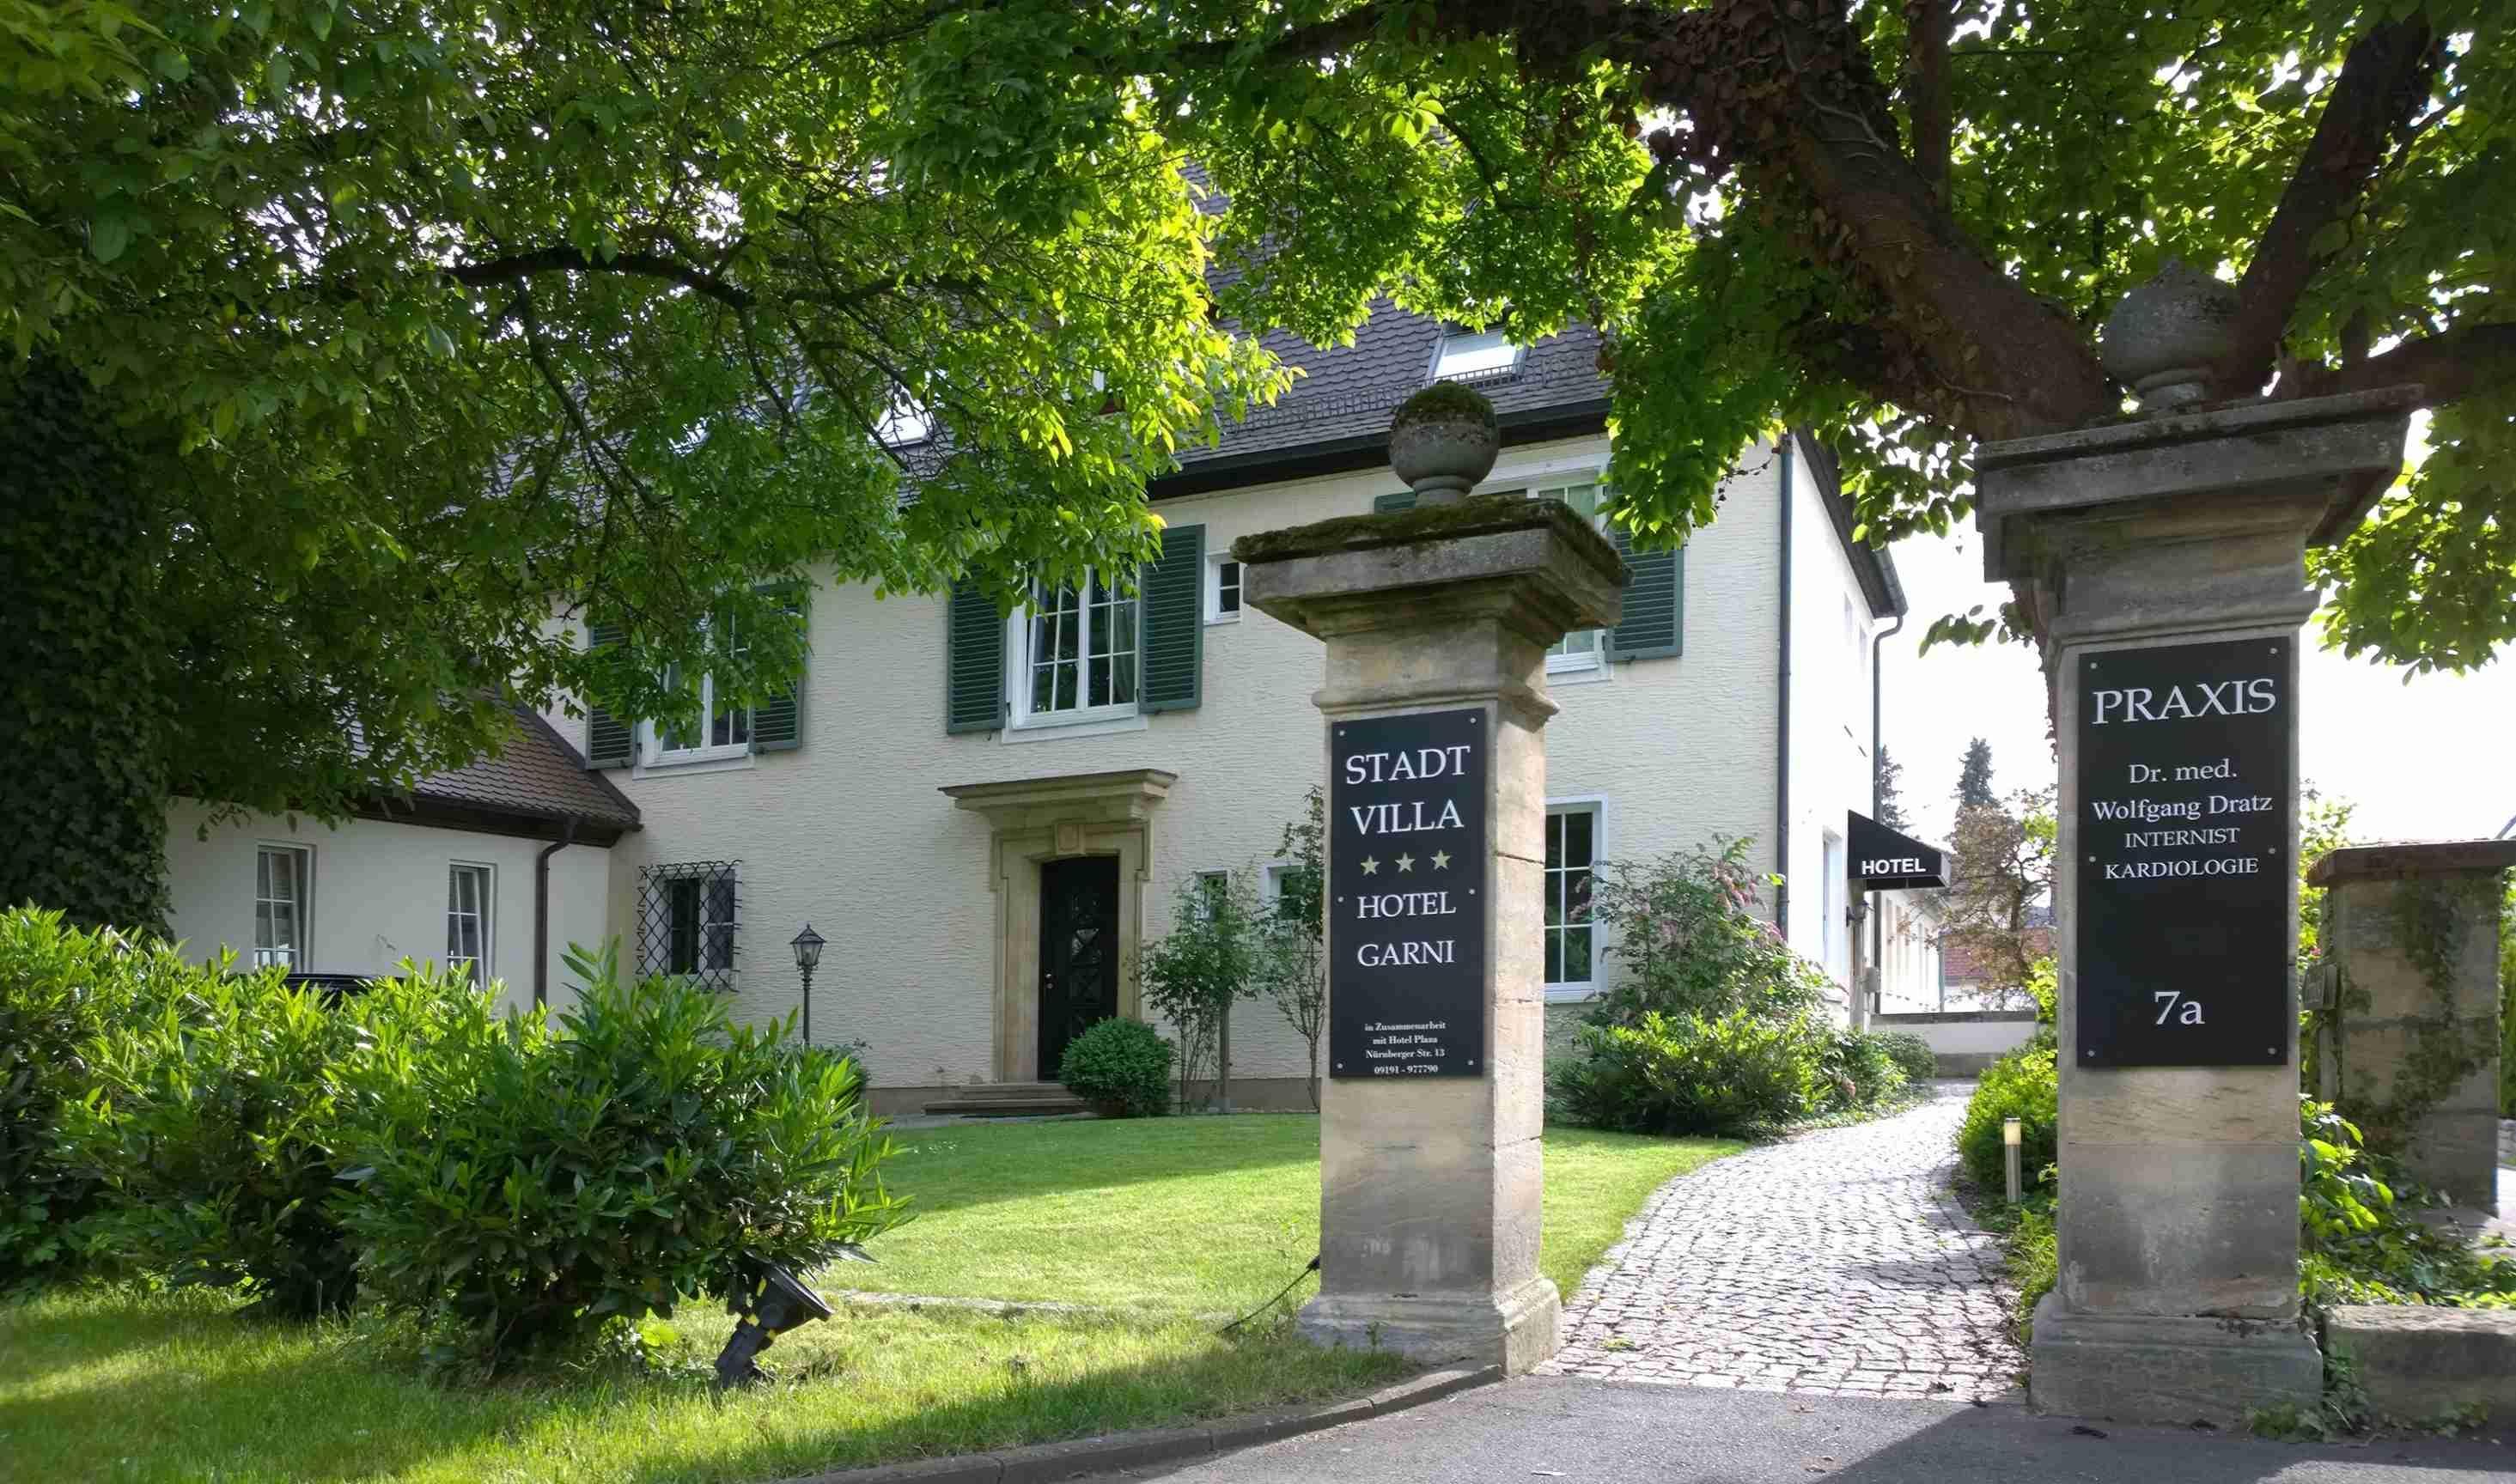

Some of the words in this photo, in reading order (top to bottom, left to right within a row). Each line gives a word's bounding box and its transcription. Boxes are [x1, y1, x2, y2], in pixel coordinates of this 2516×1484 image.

[2092, 678, 2277, 725] PRAXIS
[1345, 745, 1471, 785] STADT
[2129, 763, 2168, 784] Dr.
[2175, 757, 2238, 781] med.
[1349, 799, 1465, 835] VILLA
[2093, 800, 2202, 822] Wolfgang
[2208, 794, 2274, 815] Dratz
[2124, 827, 2241, 848] INTERNIST
[1861, 858, 1927, 875] HOTEL
[2105, 858, 2260, 879] KARDIOLOGIE
[1356, 891, 1457, 919] HOTEL
[1356, 940, 1455, 967] GARNI
[2154, 991, 2205, 1025] 7a
[1375, 1020, 1447, 1031] Zusammenarbeit
[1388, 1035, 1413, 1044] Hotel
[1365, 1049, 1416, 1060] Nürnberger
[1416, 1049, 1434, 1057] Str.
